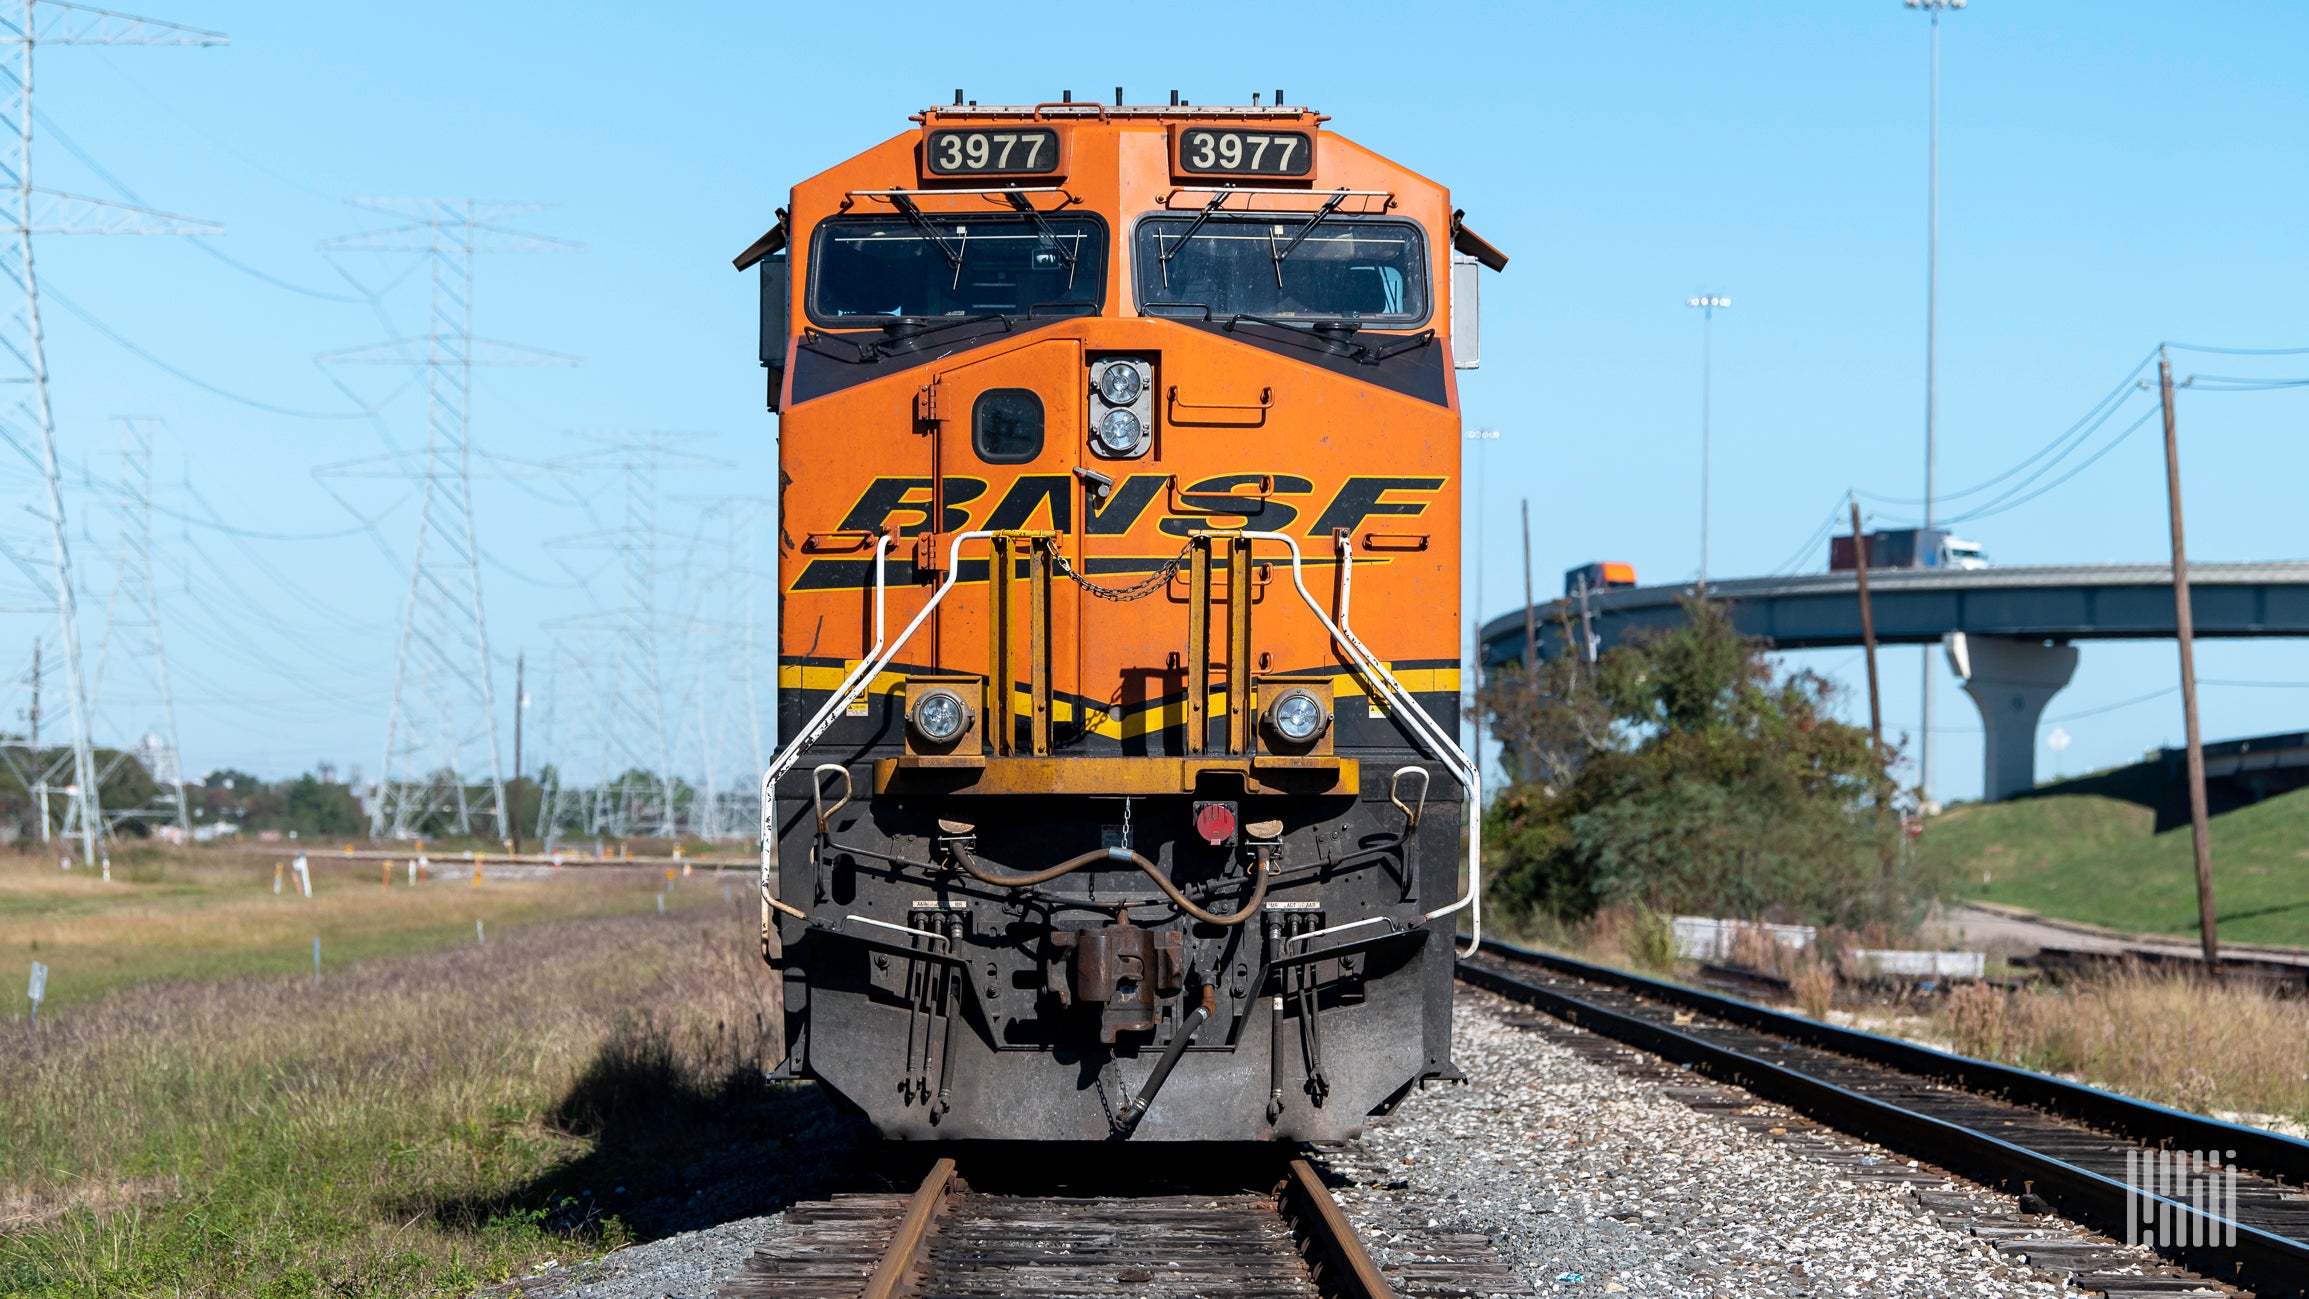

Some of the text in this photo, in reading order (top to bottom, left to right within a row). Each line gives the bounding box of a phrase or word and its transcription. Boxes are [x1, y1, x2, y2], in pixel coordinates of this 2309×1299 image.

[940, 133, 1045, 170] 3977
[1192, 132, 1298, 171] 3977
[827, 472, 1452, 541] BNSF
